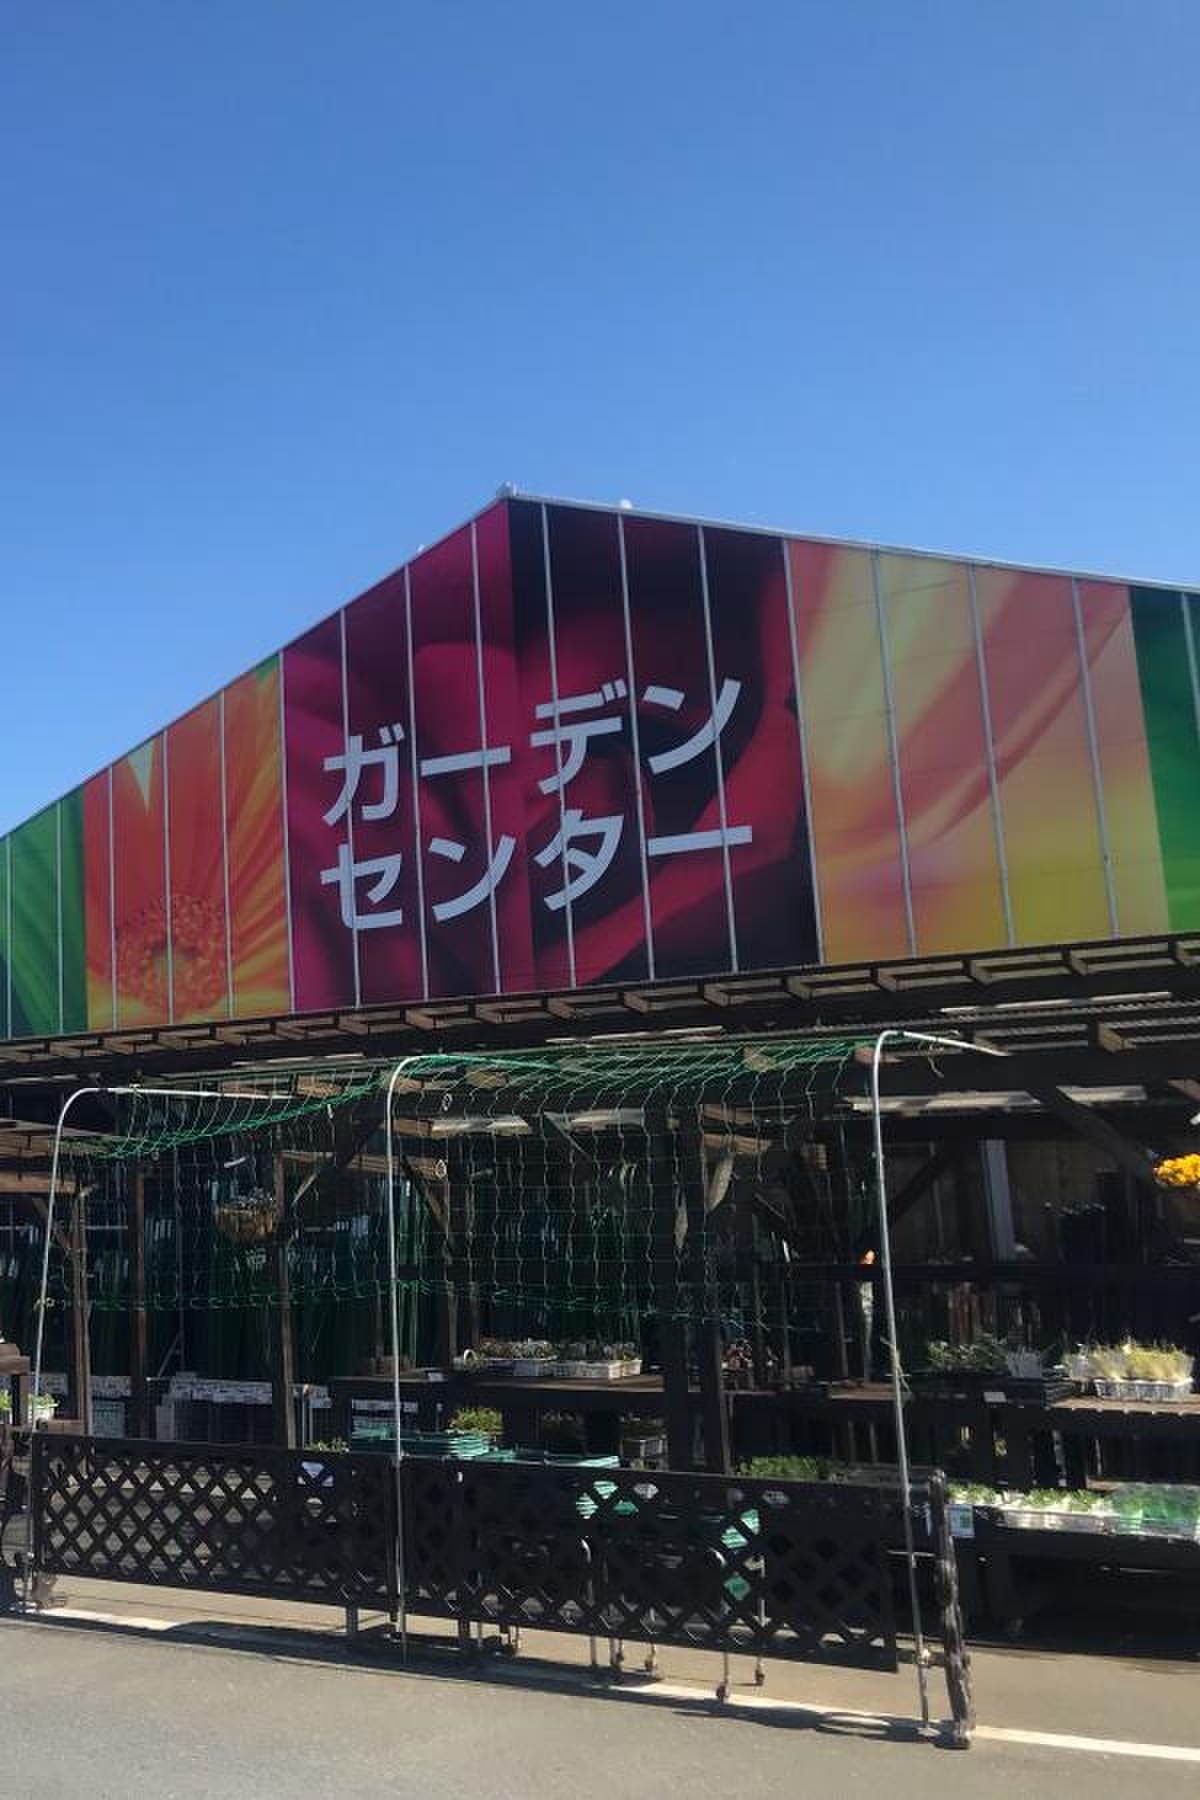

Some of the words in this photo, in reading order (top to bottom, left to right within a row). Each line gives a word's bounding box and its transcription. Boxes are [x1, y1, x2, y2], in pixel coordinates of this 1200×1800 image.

[323, 678, 741, 825] ガーデン
[320, 808, 753, 930] センター
